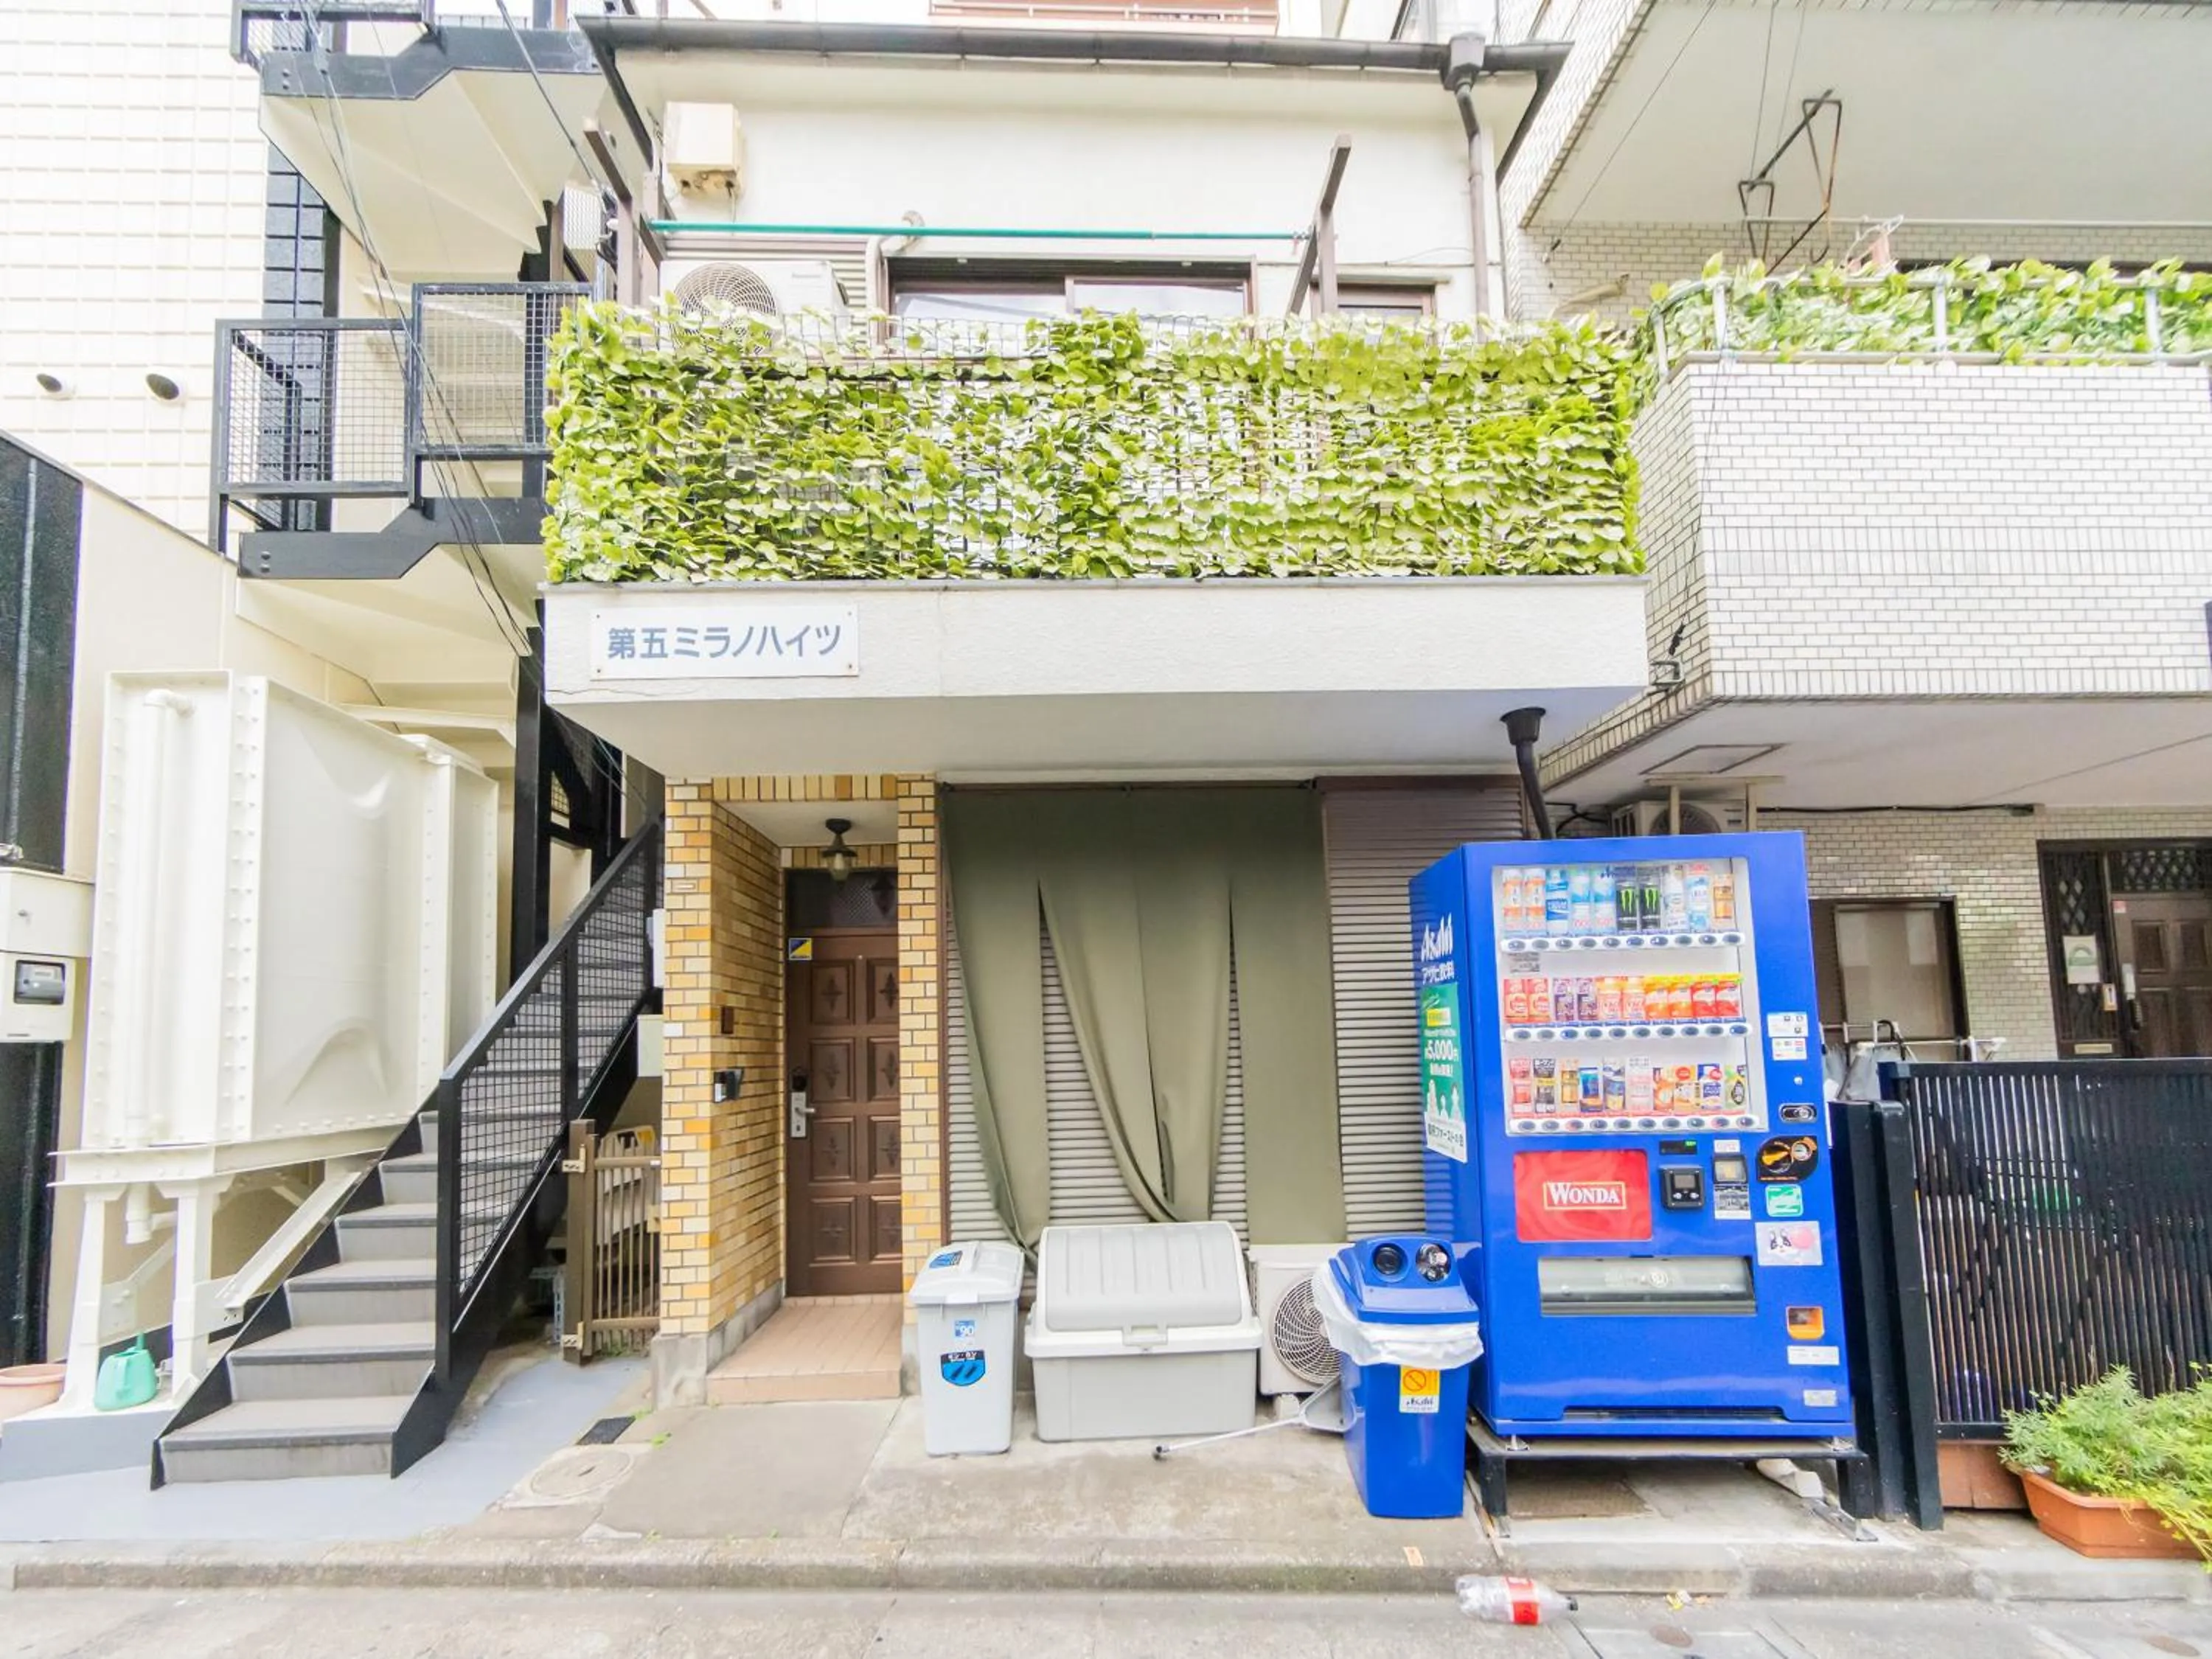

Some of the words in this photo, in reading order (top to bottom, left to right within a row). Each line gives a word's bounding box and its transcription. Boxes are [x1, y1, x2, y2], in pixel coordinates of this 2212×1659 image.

[608, 625, 842, 660] 第五ミラノハイツ
[1546, 1182, 1621, 1206] WONDA
